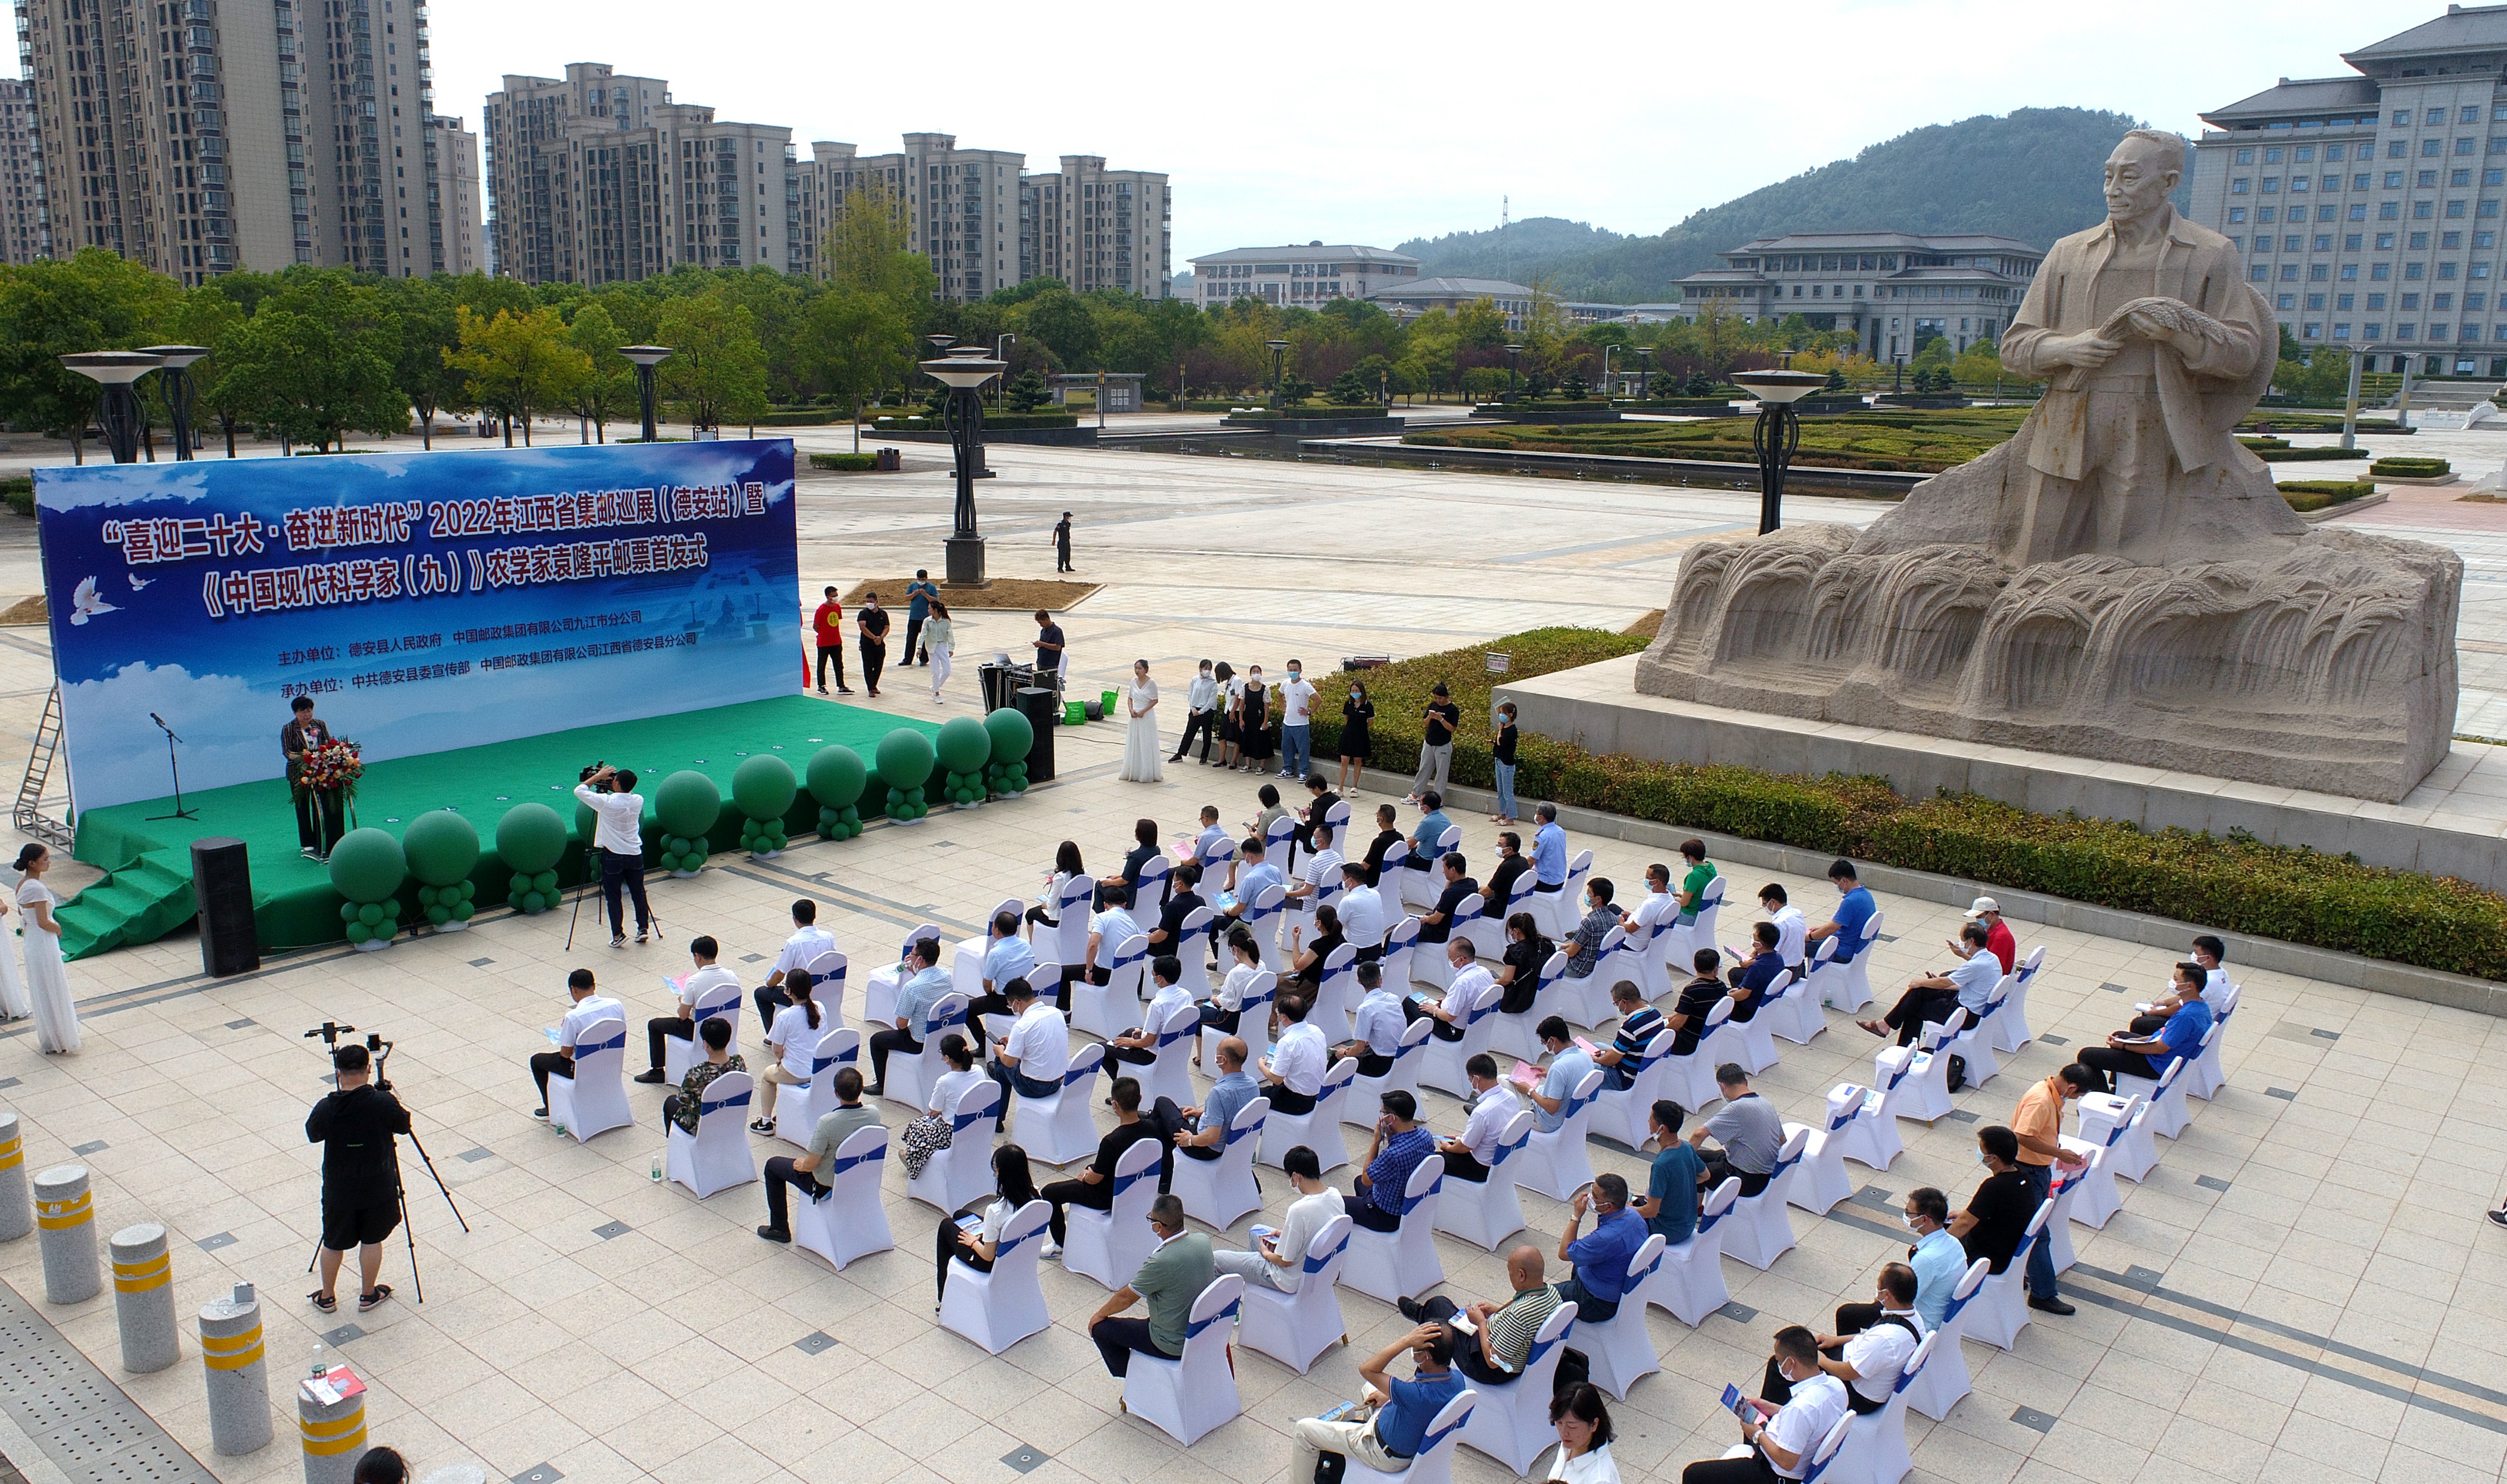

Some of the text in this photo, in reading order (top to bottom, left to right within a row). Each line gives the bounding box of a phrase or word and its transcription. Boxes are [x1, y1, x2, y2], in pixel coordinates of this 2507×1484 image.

[203, 533, 708, 617] 《中国现代科学家（九）》农学家袁隆平邮票首发式
[453, 610, 642, 645] 中国邮政集团有限公司九江市分公司
[480, 632, 696, 672] 中国邮政集团有限公司江西省德安县分公司
